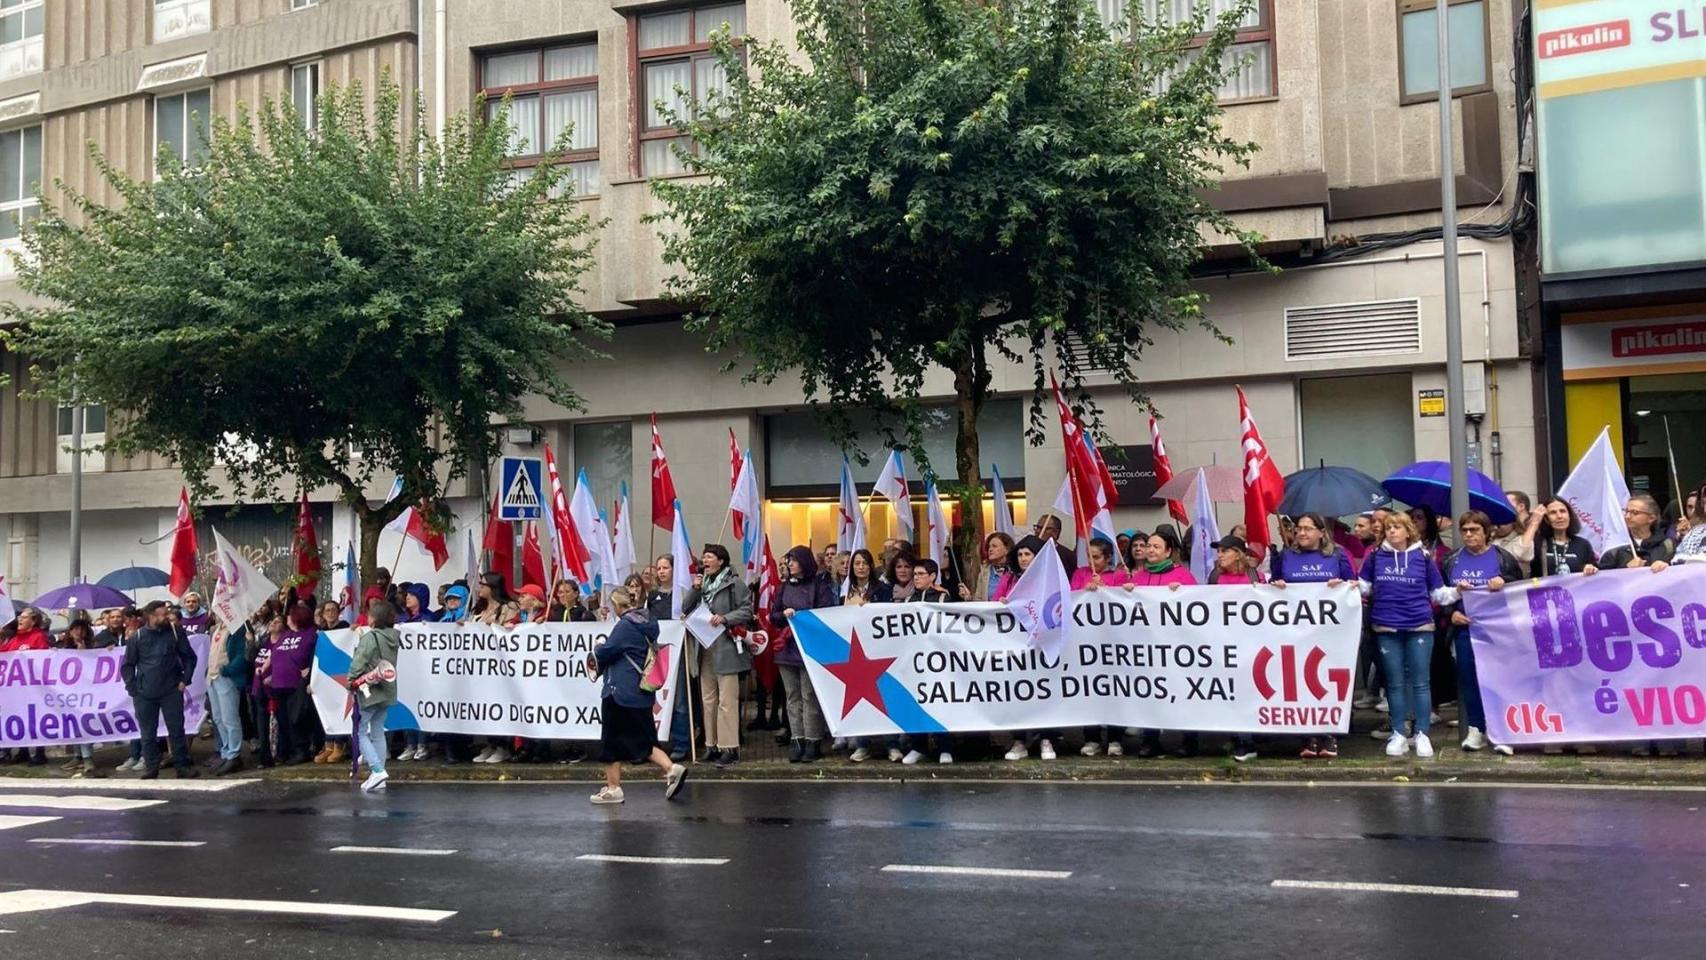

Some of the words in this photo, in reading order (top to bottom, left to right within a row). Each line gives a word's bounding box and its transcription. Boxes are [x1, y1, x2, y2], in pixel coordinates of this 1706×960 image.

[1650, 6, 1706, 42] SL
[1545, 26, 1623, 56] pikolin
[1376, 575, 1417, 584] MONFORTE
[1384, 566, 1407, 575] SAF
[871, 611, 985, 639] SERVIZO
[996, 612, 1028, 634] D
[1160, 601, 1209, 626] NO
[1223, 599, 1341, 626] FOGAR
[527, 634, 551, 652] DE
[432, 657, 441, 675] E
[446, 657, 516, 677] CENTROS
[523, 659, 548, 678] DE
[556, 655, 588, 678] DÍA
[913, 649, 1068, 672] CONVENIO,
[1079, 644, 1213, 668] DEREITOS
[1224, 645, 1238, 668] E
[917, 678, 1052, 704] SALARIOS
[1061, 675, 1176, 703] DIGNOS,
[1187, 677, 1235, 701] XA!
[1594, 679, 1619, 714] é
[0, 702, 138, 741] olencia
[417, 700, 503, 721] CONVENIO
[510, 704, 569, 724] DIGNO
